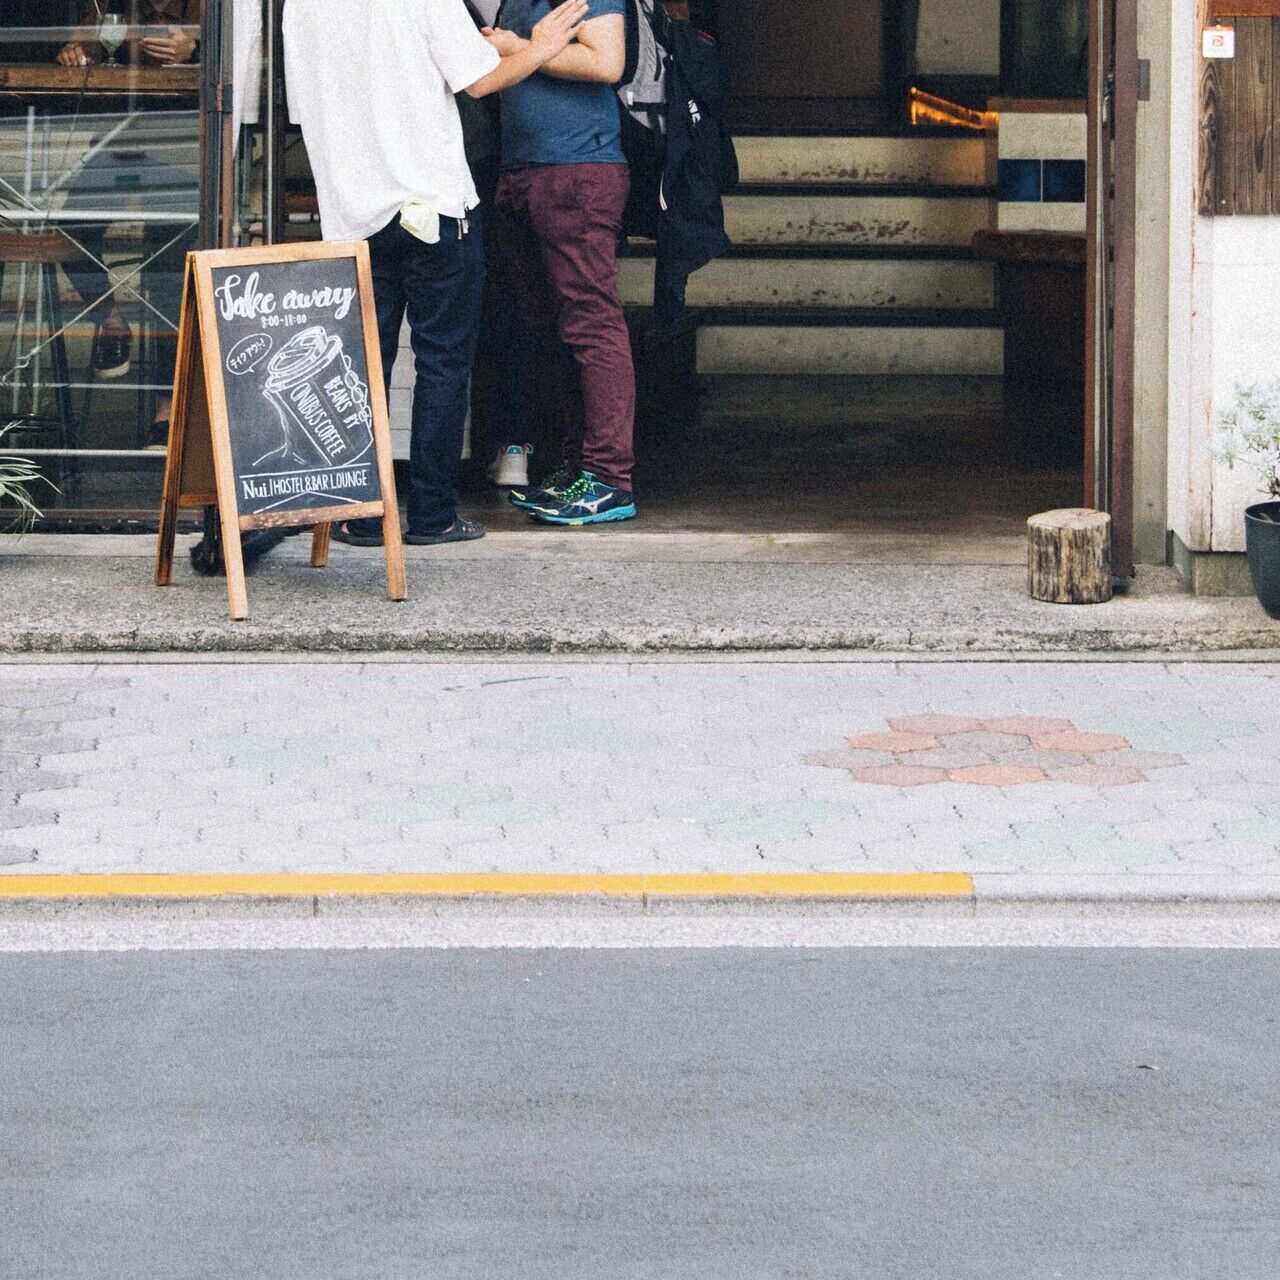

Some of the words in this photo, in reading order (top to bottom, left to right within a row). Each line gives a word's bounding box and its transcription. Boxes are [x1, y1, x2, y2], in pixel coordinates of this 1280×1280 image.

[215, 271, 277, 321] Take
[282, 286, 357, 320] away
[289, 381, 327, 426] ONIBUS
[314, 419, 347, 458] COFFEE
[323, 375, 352, 413] BEANS
[343, 412, 361, 429] BY
[329, 469, 367, 490] LOUNGE
